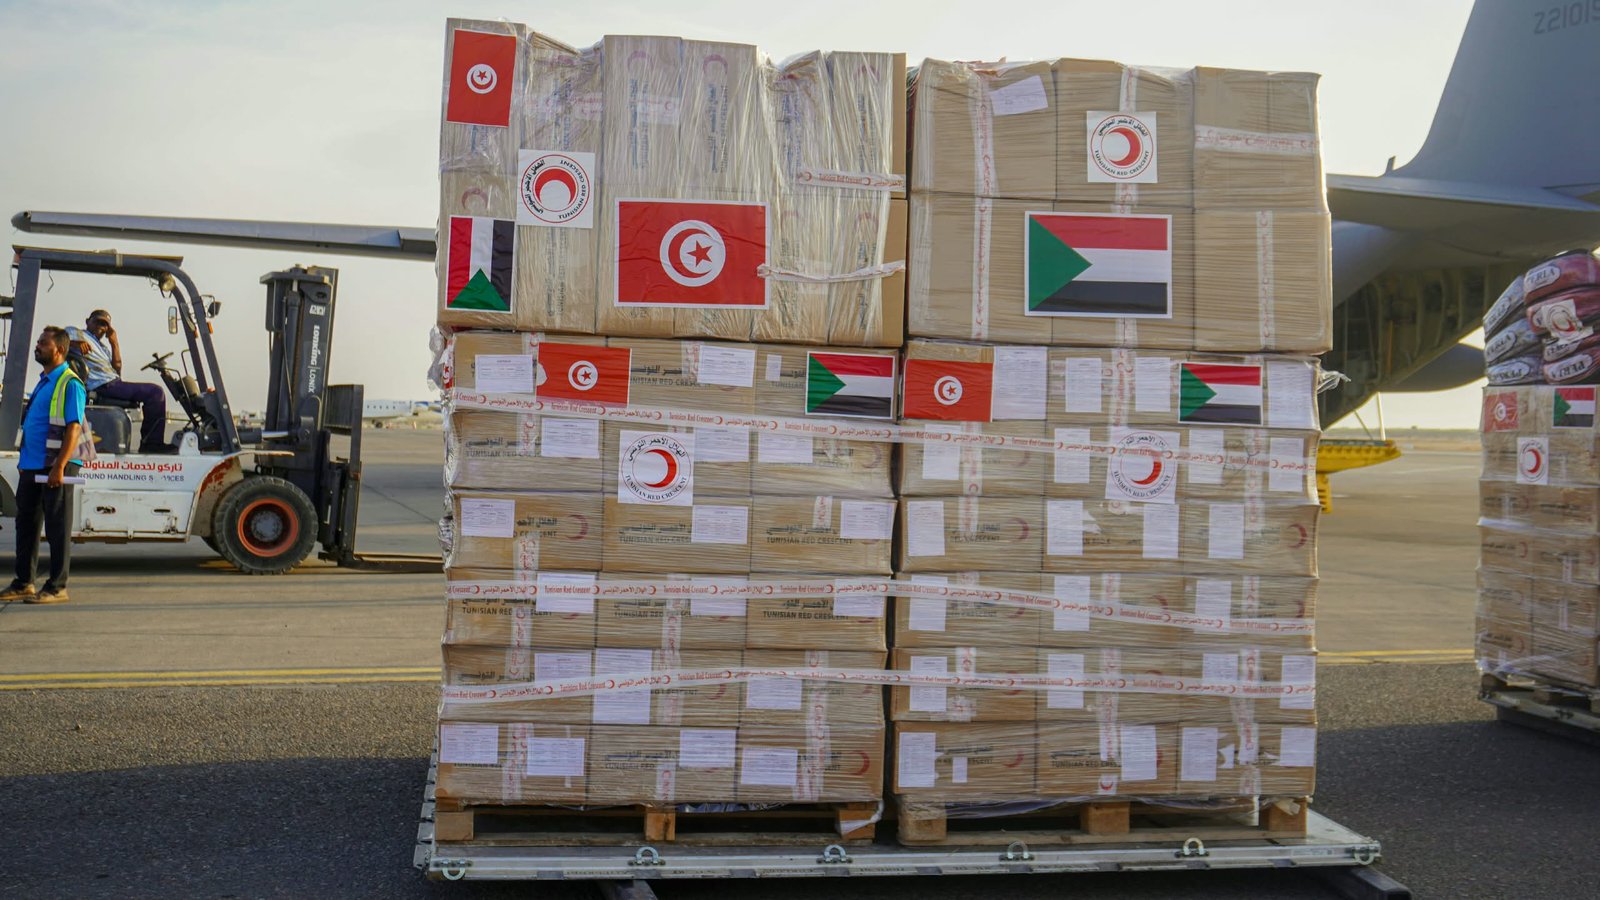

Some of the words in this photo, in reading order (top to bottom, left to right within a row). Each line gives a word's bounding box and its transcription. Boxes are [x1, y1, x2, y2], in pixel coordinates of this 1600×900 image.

[1095, 150, 1116, 174] TUNISIAN
[1129, 150, 1150, 174] CRESCENT
[560, 160, 585, 183] CRESCENT
[558, 198, 584, 219] TUNISIAN
[308, 369, 316, 393] LONIX
[121, 461, 155, 471] لخدمات
[158, 462, 182, 473] تاركو
[626, 475, 647, 497] TUNISIAN
[661, 477, 687, 499] CRESCENT
[767, 537, 800, 545] TUNISIAN
[544, 585, 562, 594] Tunisian
[563, 585, 571, 594] Red
[572, 586, 590, 594] Crescent
[462, 607, 497, 616] TUNISIAN
[763, 610, 797, 619] TUNISIAN
[798, 611, 812, 619] RED
